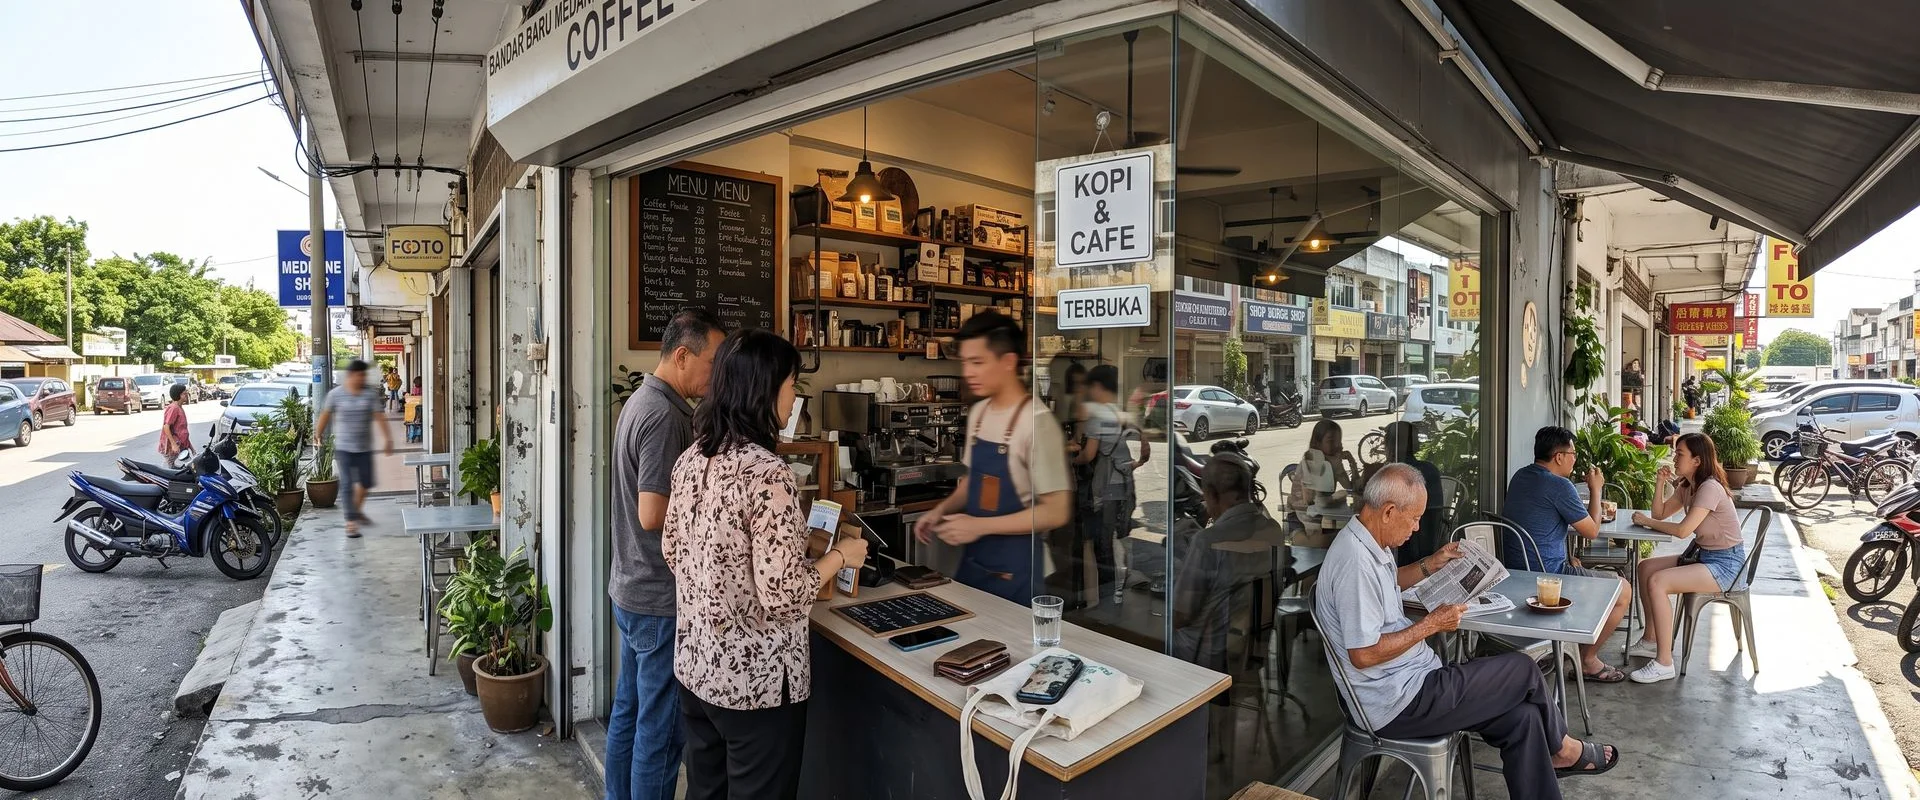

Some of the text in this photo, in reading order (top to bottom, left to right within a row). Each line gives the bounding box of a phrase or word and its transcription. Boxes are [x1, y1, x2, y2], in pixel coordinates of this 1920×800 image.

[489, 0, 595, 77] BANDAR BARU MED
[668, 173, 750, 202] MENU MENU
[1074, 166, 1132, 199] KOPI
[1093, 199, 1111, 225] &
[1070, 224, 1136, 255] CAFE
[281, 260, 342, 274] MEDINE
[1772, 284, 1808, 300] TO
[1064, 296, 1143, 319] TERBUKA
[1249, 304, 1267, 318] SHOP
